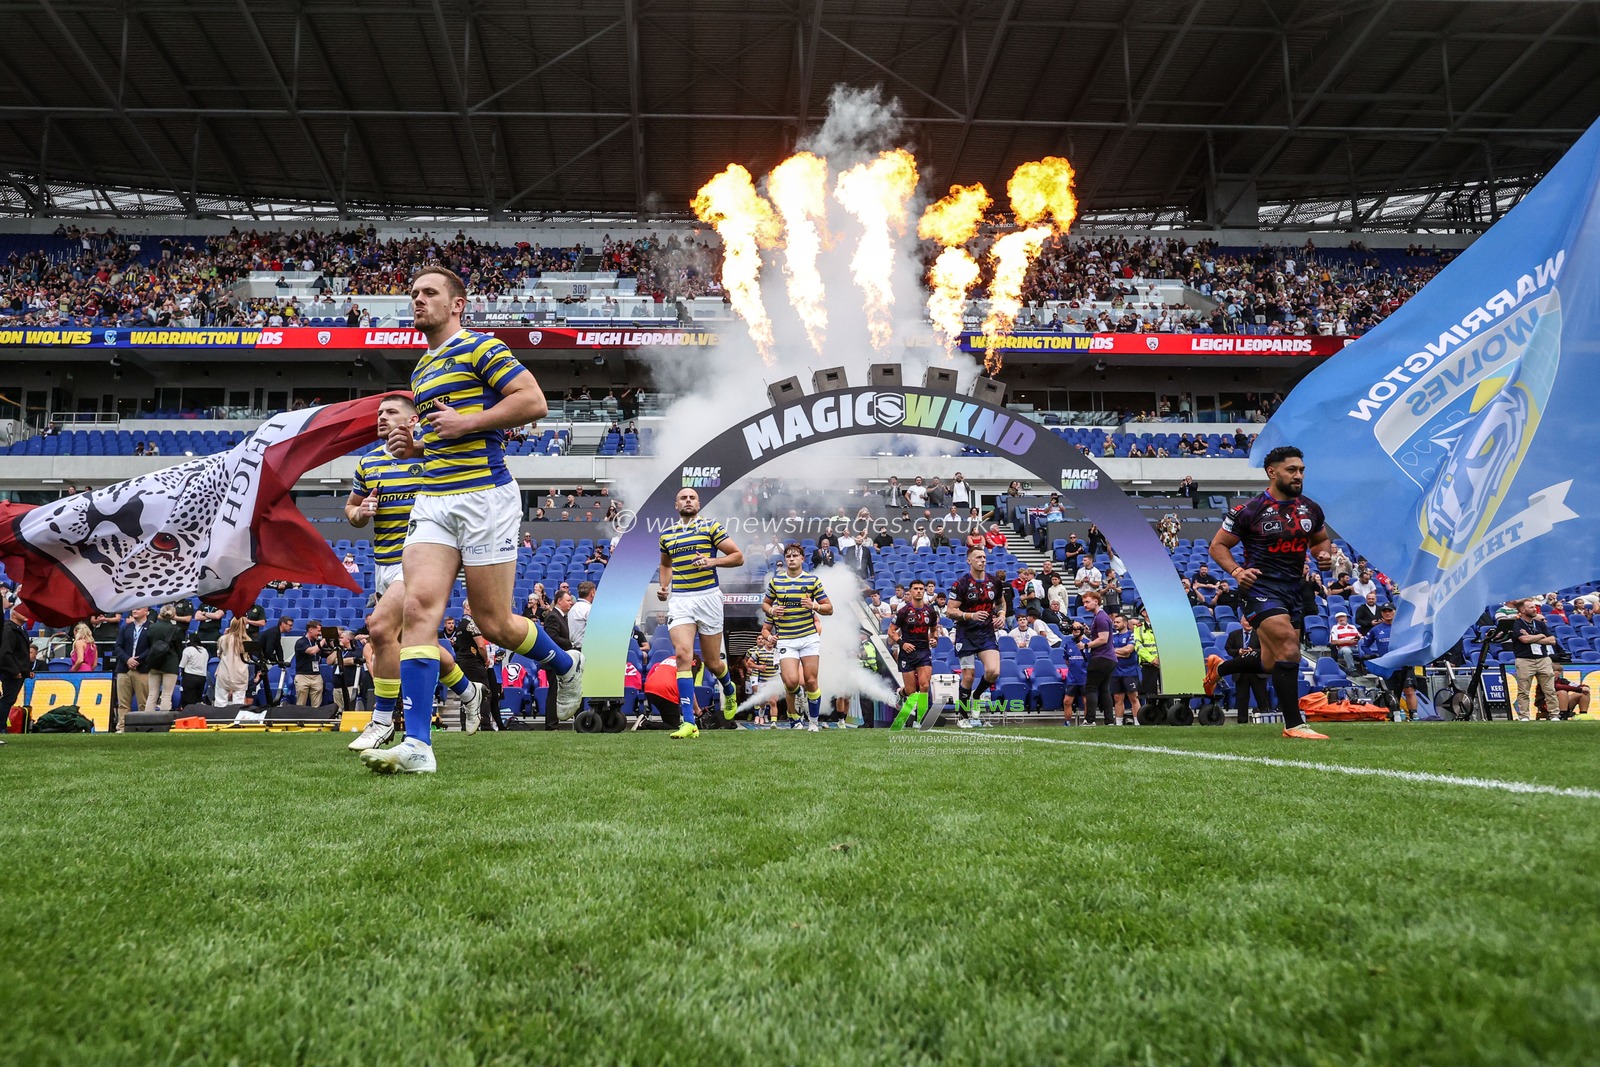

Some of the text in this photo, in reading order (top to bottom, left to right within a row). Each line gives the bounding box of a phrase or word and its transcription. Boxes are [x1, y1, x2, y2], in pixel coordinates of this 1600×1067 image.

[572, 284, 587, 294] 303
[26, 331, 92, 345] WOLVES
[130, 331, 239, 345] WARRINGTON
[365, 332, 412, 345] LEIGH
[576, 332, 622, 345] LEIGH
[1191, 338, 1312, 352] LEIGH LEOPARDS
[742, 391, 1036, 460] MAGIC WKND
[682, 467, 721, 477] MAGIC
[1061, 469, 1099, 479] MAGIC
[682, 477, 721, 487] WKND
[1061, 480, 1099, 489] WKND
[1268, 538, 1307, 553] Jet2
[723, 594, 760, 603] BETFRED
